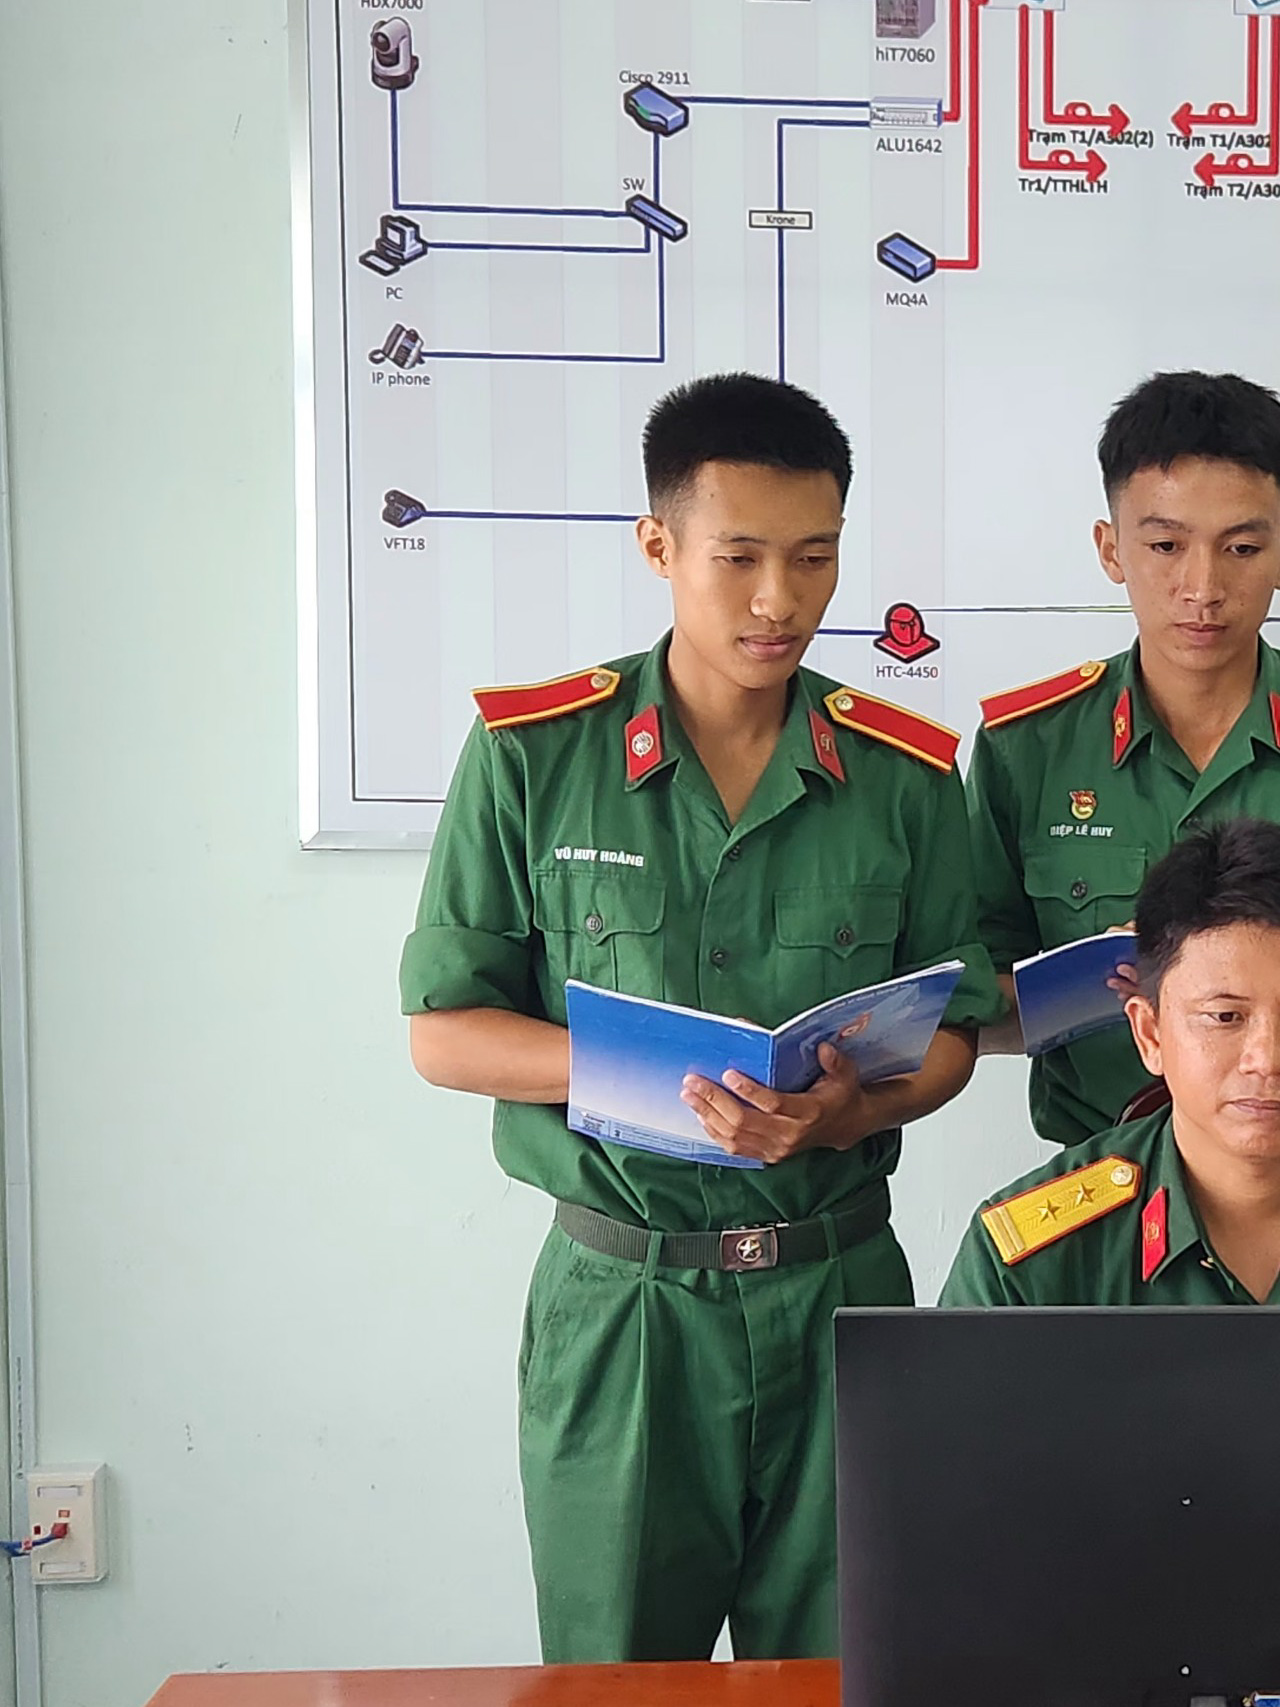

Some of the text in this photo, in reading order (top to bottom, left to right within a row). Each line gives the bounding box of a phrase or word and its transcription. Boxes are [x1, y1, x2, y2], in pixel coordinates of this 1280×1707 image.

[876, 47, 935, 63] hiT7060
[619, 70, 690, 85] Cisco 2911
[876, 137, 942, 153] ALU1642
[623, 178, 645, 191] SW
[766, 215, 796, 225] Krone
[386, 286, 403, 300] PC
[886, 292, 928, 307] MQ4A
[372, 372, 431, 387] IP phone
[384, 537, 425, 550] VFT18
[876, 665, 938, 678] HTC-4450
[1090, 826, 1114, 837] HUY
[573, 848, 598, 862] HUY
